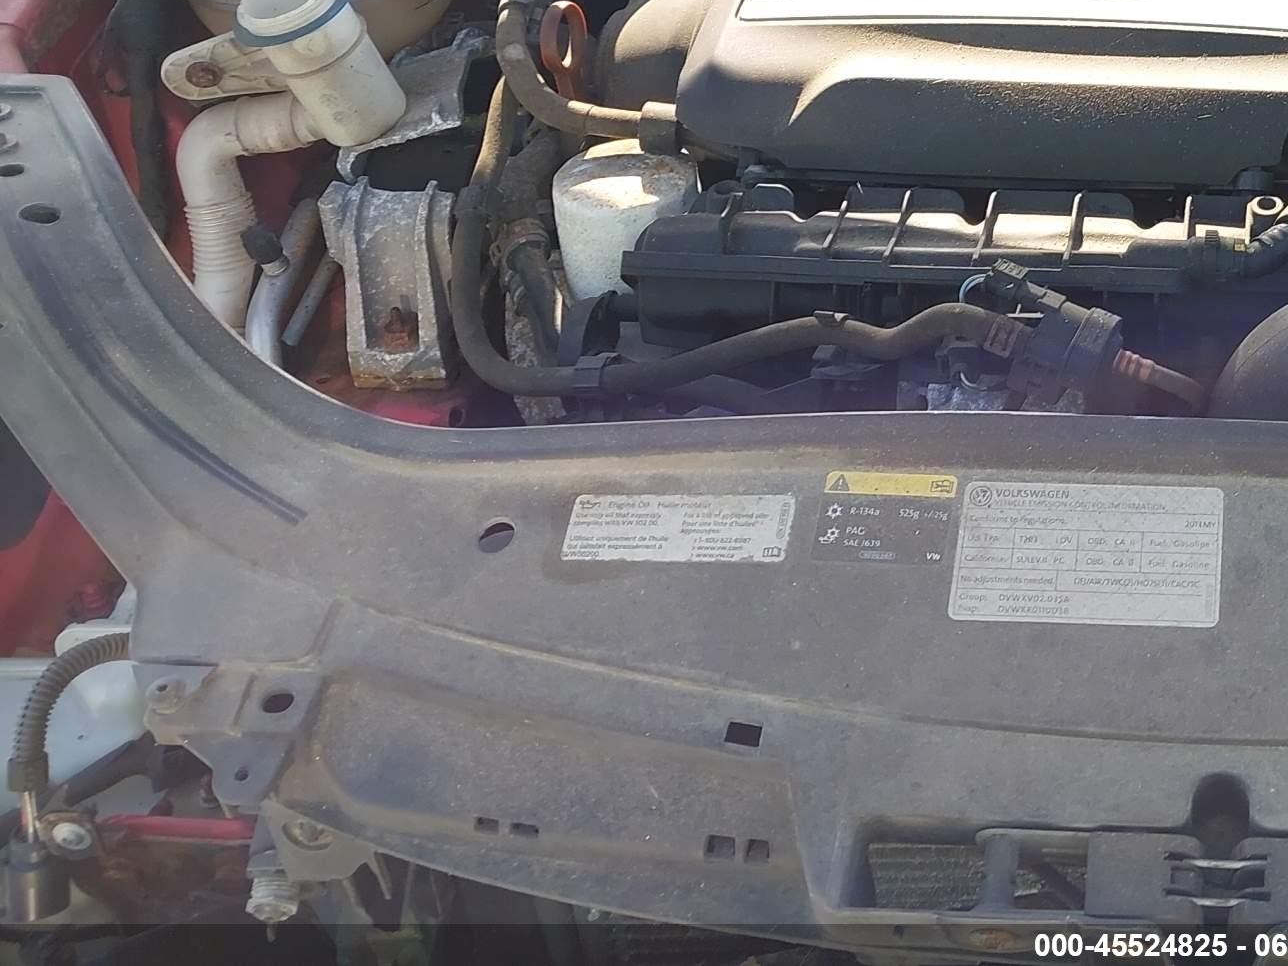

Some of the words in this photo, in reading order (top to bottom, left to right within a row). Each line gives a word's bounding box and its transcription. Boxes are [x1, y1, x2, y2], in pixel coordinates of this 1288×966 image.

[994, 489, 1070, 499] VOLKSWAGEN
[849, 506, 880, 516] R-134a
[845, 526, 865, 535] PAG
[926, 551, 941, 561] VW
